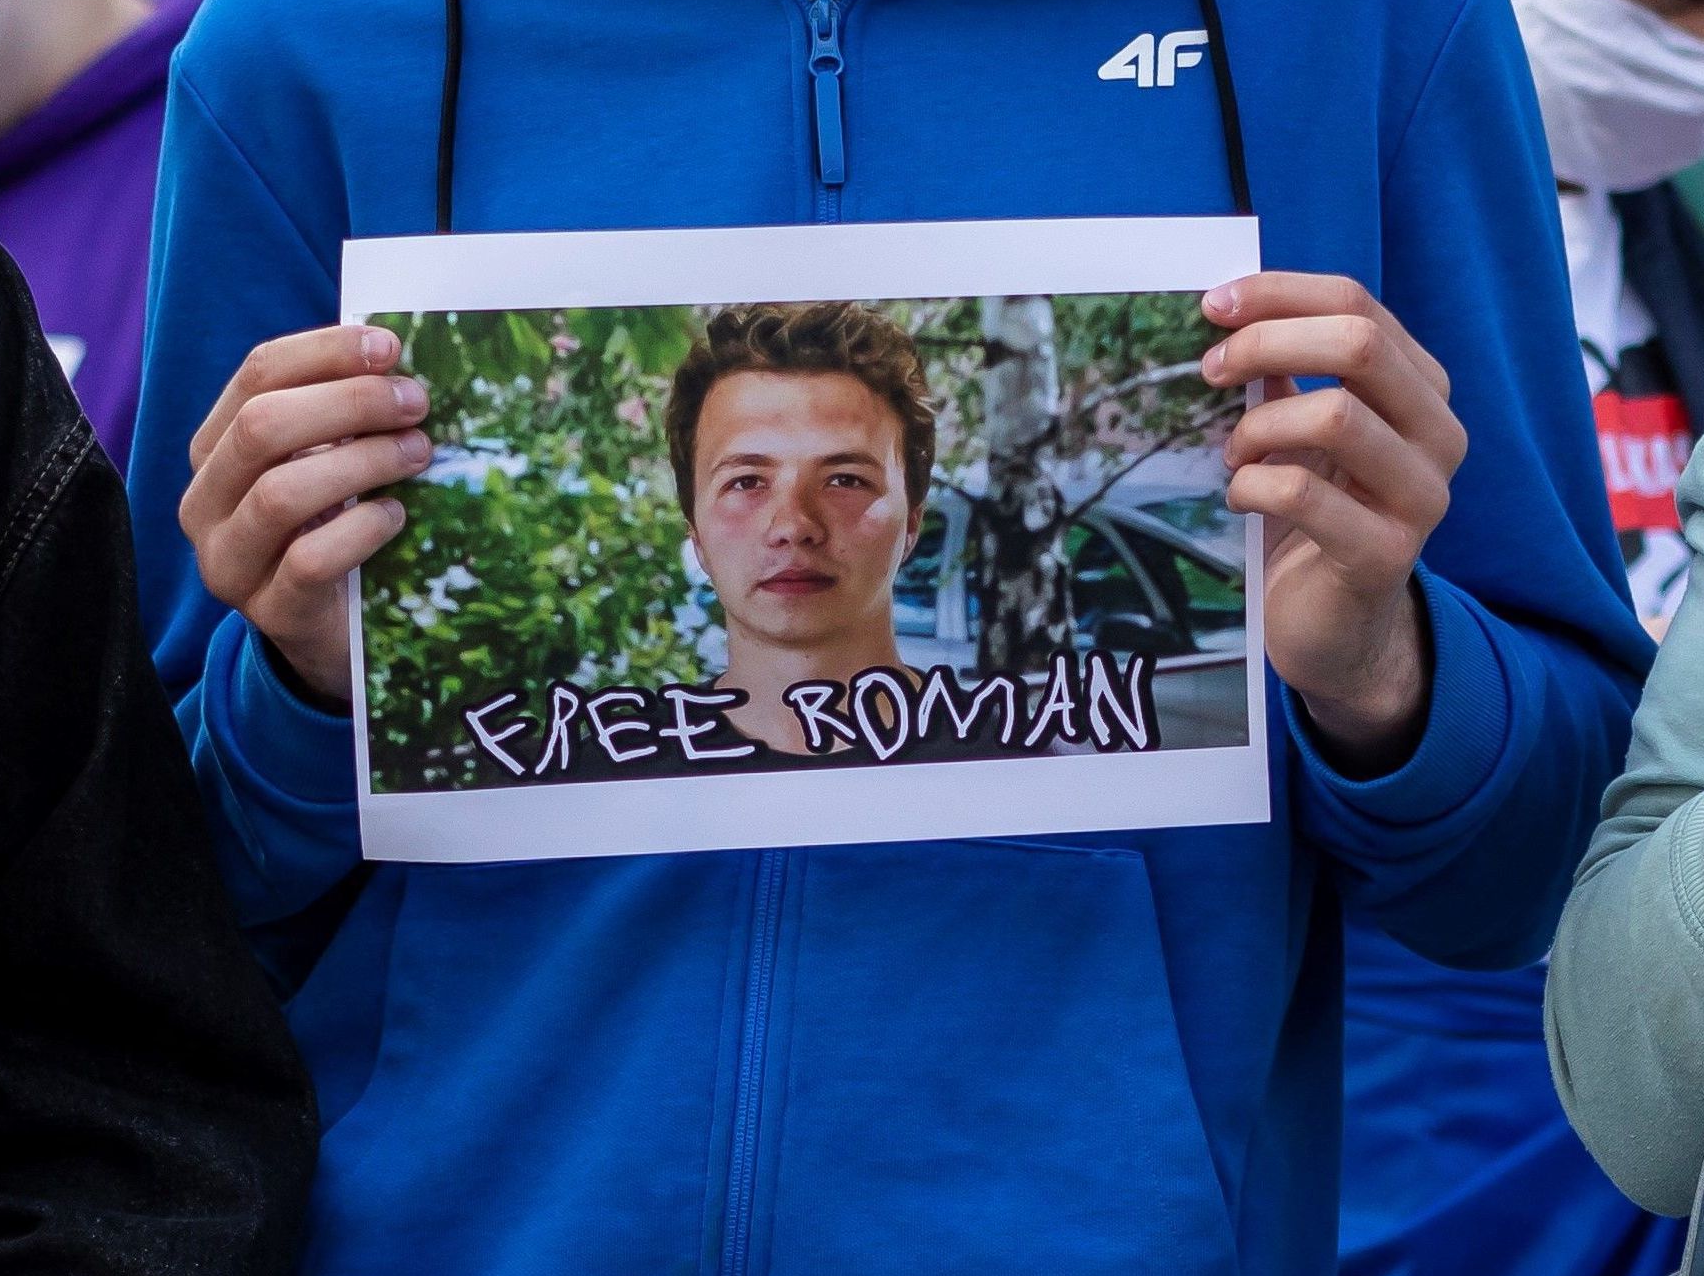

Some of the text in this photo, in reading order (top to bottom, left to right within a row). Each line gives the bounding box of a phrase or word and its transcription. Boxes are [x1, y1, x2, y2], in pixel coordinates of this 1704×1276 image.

[1098, 29, 1209, 87] 4F
[464, 655, 1151, 776] FREE ROMAN
